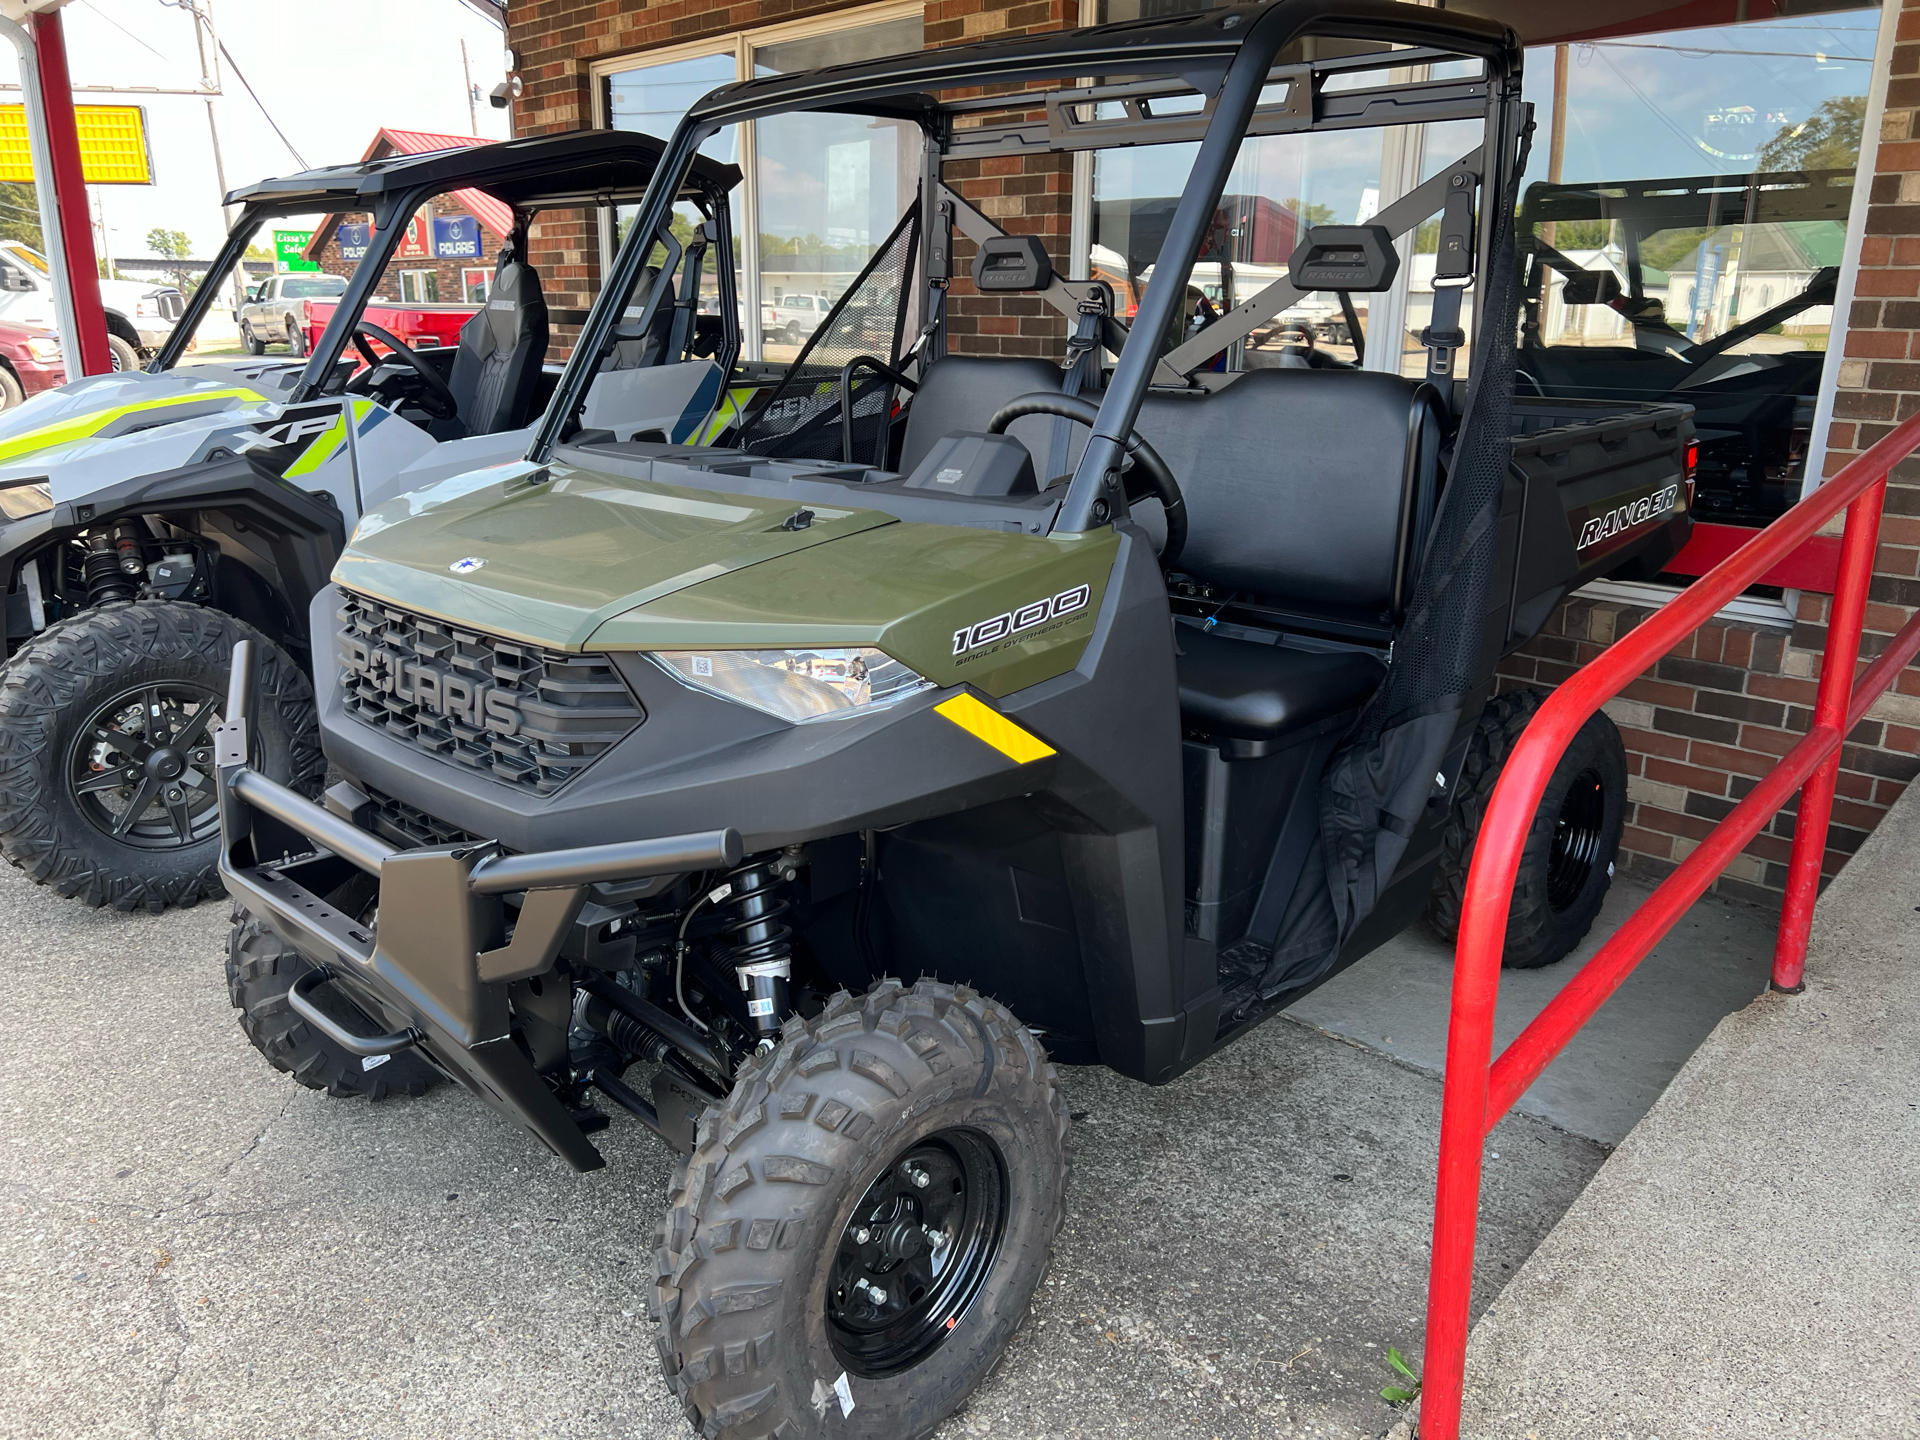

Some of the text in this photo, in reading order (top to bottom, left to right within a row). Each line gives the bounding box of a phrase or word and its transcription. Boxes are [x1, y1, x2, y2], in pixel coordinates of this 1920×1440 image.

[277, 233, 306, 243] Lissa's
[438, 241, 476, 255] POLARIS
[984, 274, 1027, 283] RANGER
[1305, 271, 1366, 280] RANGER
[233, 413, 341, 455] XP
[1576, 483, 1678, 551] RANGER
[952, 583, 1092, 656] 1000
[954, 611, 1089, 667] SINGLE OVERHEAD CAM
[350, 637, 524, 736] POLARIS
